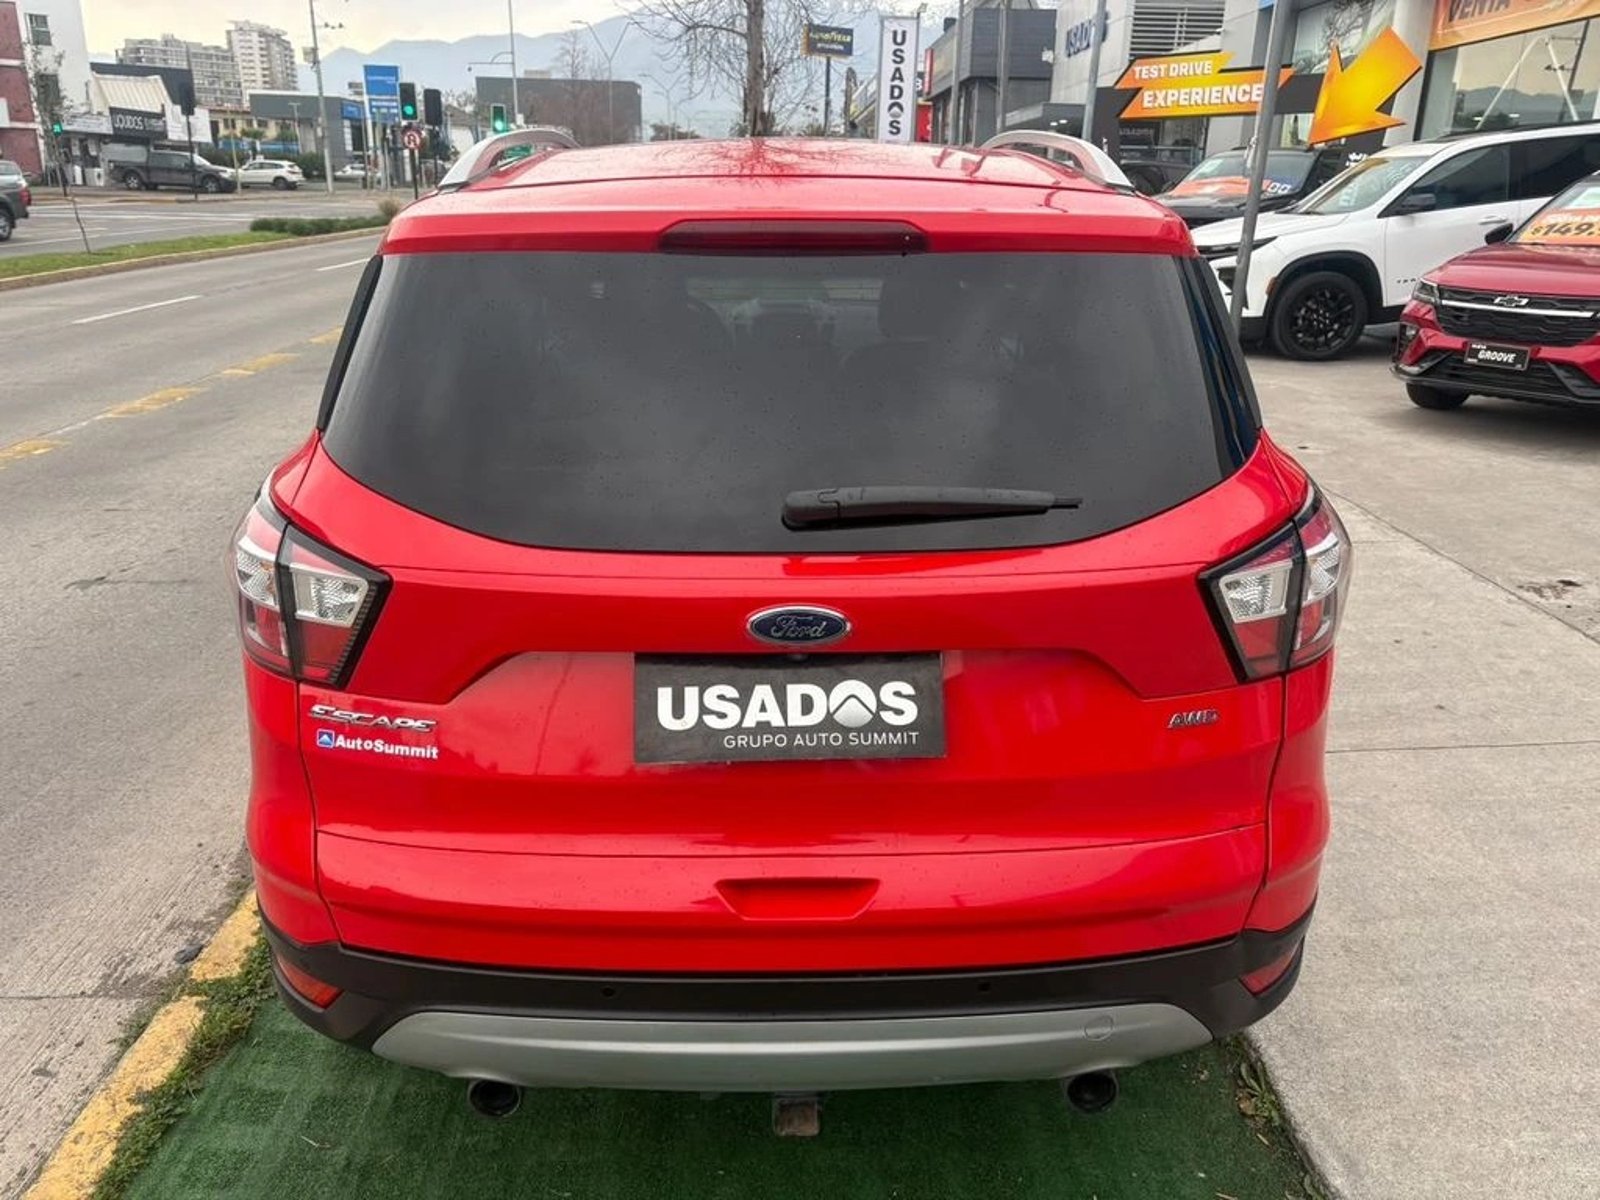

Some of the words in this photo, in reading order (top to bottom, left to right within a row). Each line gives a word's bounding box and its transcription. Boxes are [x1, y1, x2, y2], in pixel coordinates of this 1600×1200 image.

[1133, 64, 1168, 79] TEST
[1169, 60, 1213, 76] DRIVE
[888, 30, 907, 136] USADOS
[1142, 83, 1264, 108] EXPERIENCE
[1477, 349, 1517, 363] GROOVE
[770, 615, 826, 639] Ford
[657, 680, 918, 731] USADOS
[310, 704, 437, 732] ESCAPE
[1167, 709, 1218, 729] AWD
[335, 734, 438, 759] AutoSummit
[723, 734, 787, 749] GRUPO
[793, 732, 843, 747] AUTO
[849, 731, 919, 746] SUMMIT
